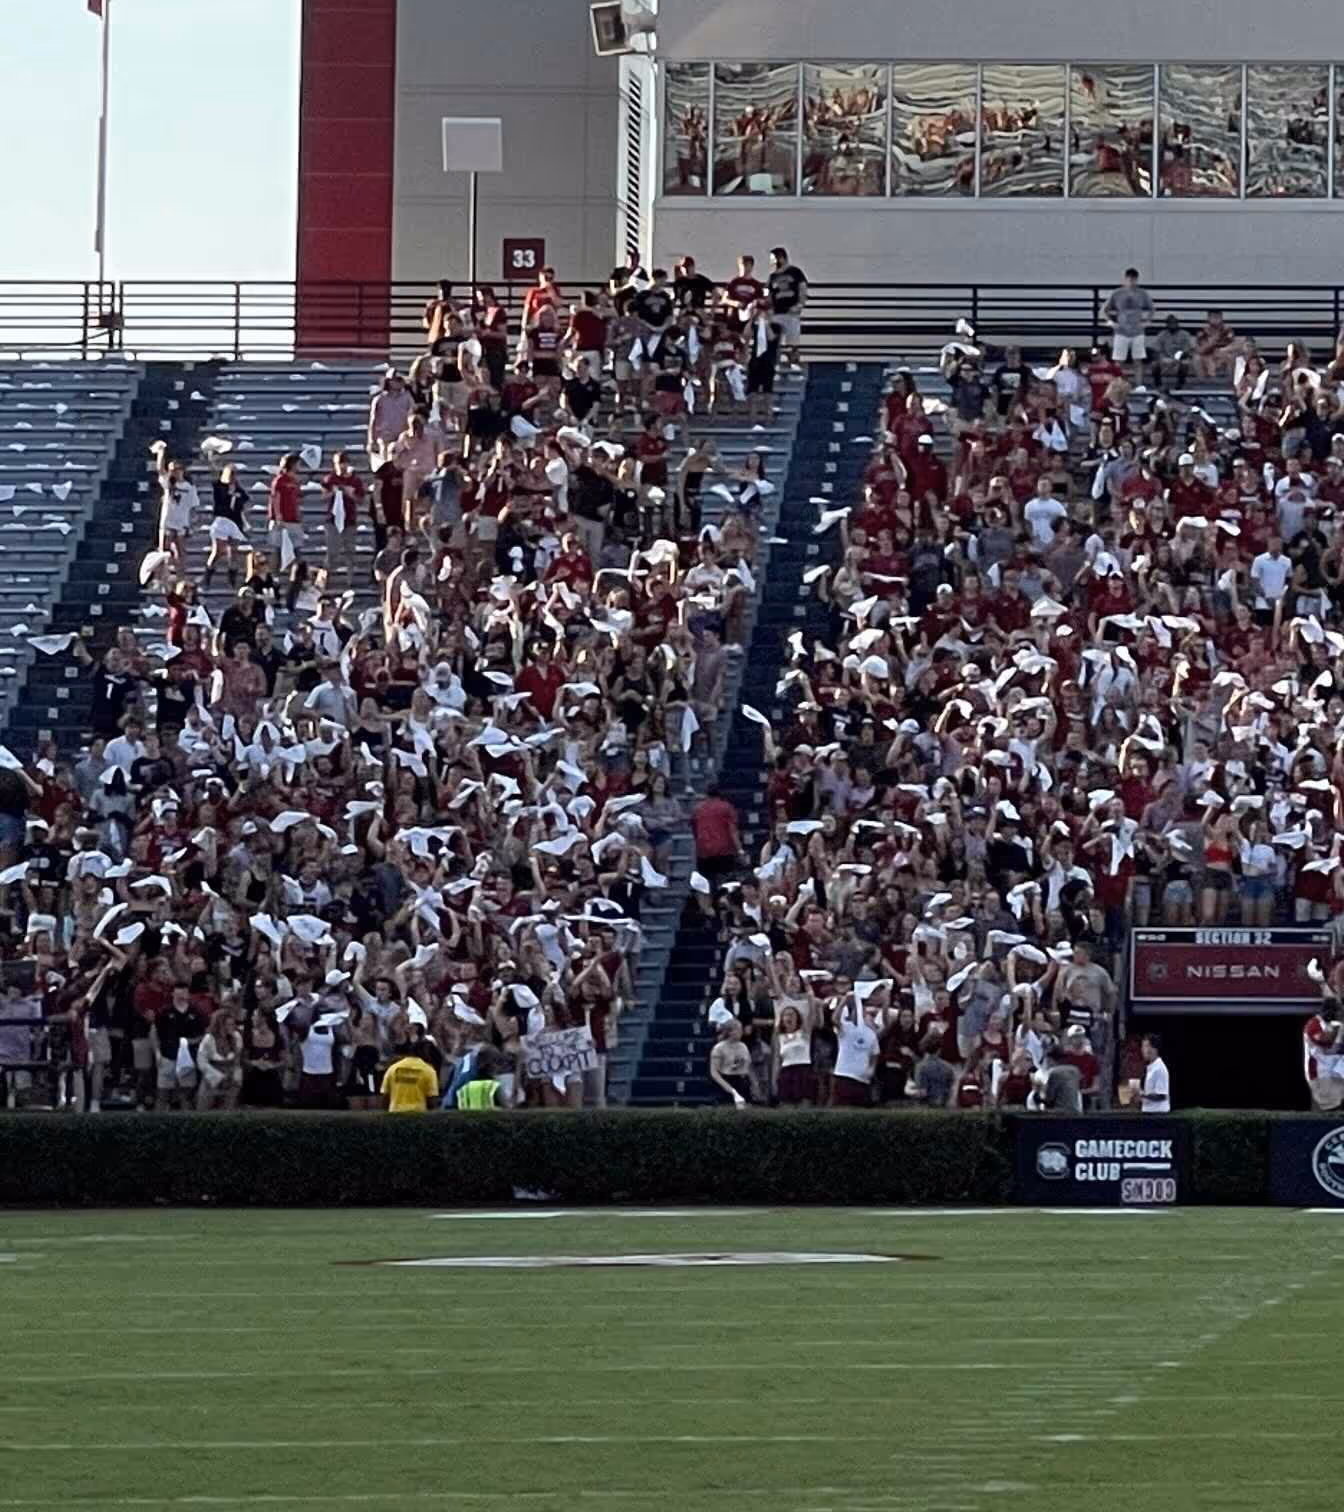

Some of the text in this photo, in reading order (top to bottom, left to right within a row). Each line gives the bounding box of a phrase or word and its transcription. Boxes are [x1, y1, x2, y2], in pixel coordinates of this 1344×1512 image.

[512, 249, 535, 268] 33
[1194, 931, 1273, 945] SECTION 32
[1186, 964, 1281, 979] NISSAN
[1074, 1139, 1174, 1159] GAMECOCK
[1074, 1162, 1121, 1182] CLUB
